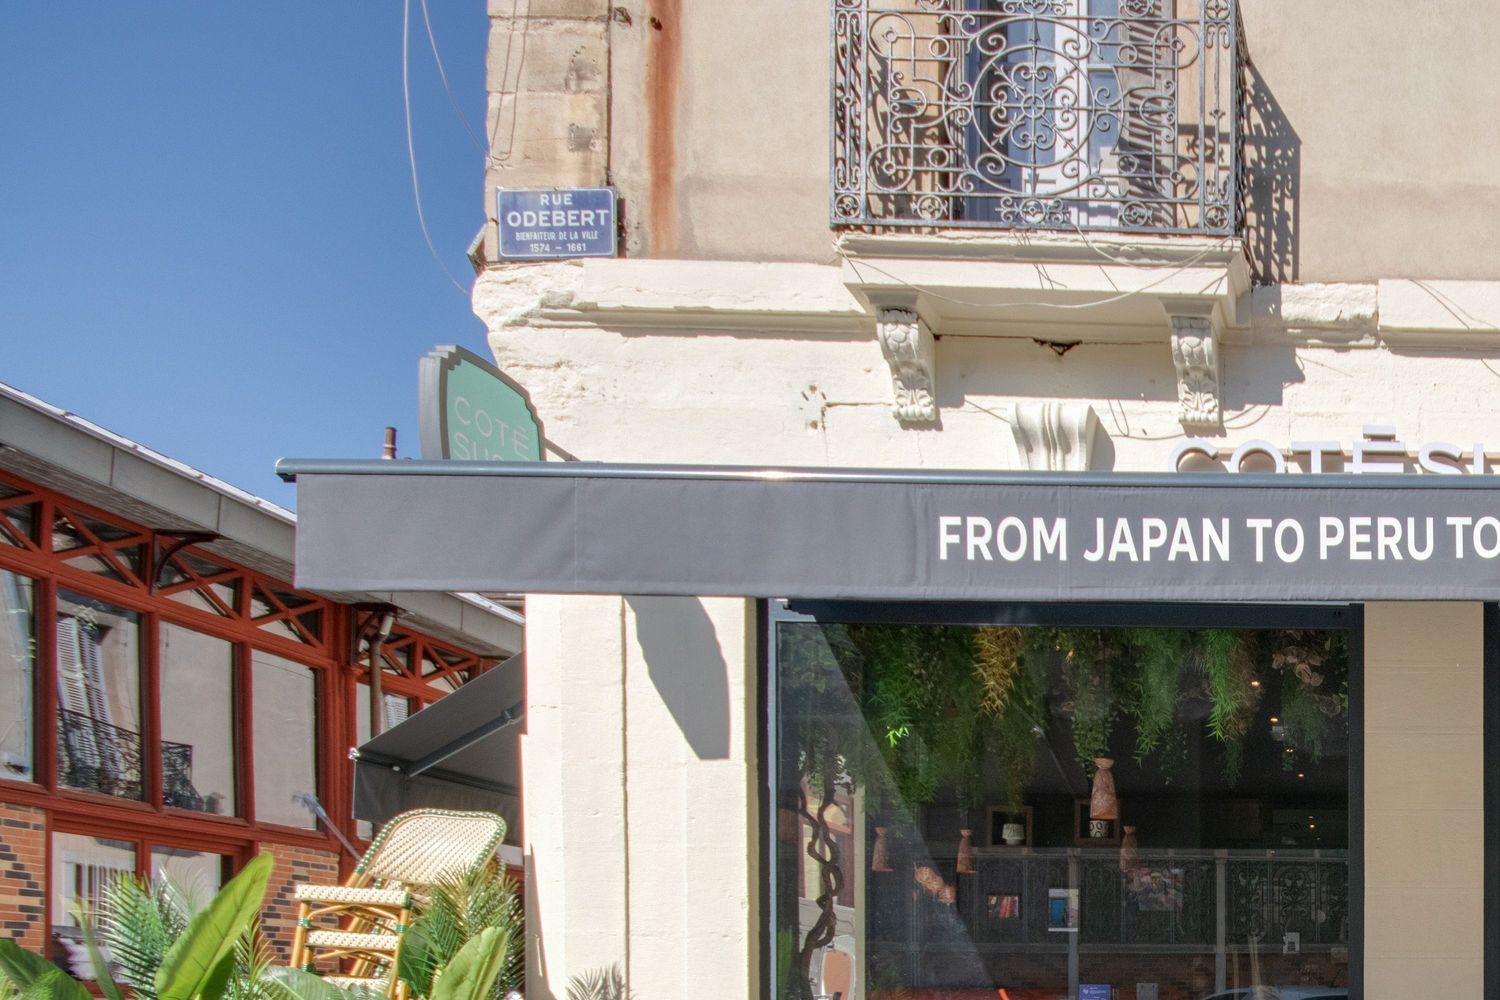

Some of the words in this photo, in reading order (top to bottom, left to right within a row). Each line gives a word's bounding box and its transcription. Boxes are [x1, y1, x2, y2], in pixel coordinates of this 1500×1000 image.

[540, 194, 573, 206] RUE
[507, 209, 609, 227] ODEBERT
[515, 232, 556, 241] BIENFAITEUR
[558, 232, 568, 240] DE
[570, 231, 579, 240] LA
[582, 230, 599, 240] VILLE
[530, 243, 550, 252] 1574
[566, 243, 586, 252] 1661
[938, 516, 1068, 562] FROM
[1083, 516, 1230, 562] JAPAN
[1246, 517, 1306, 563] TO
[1319, 515, 1435, 561] PERU
